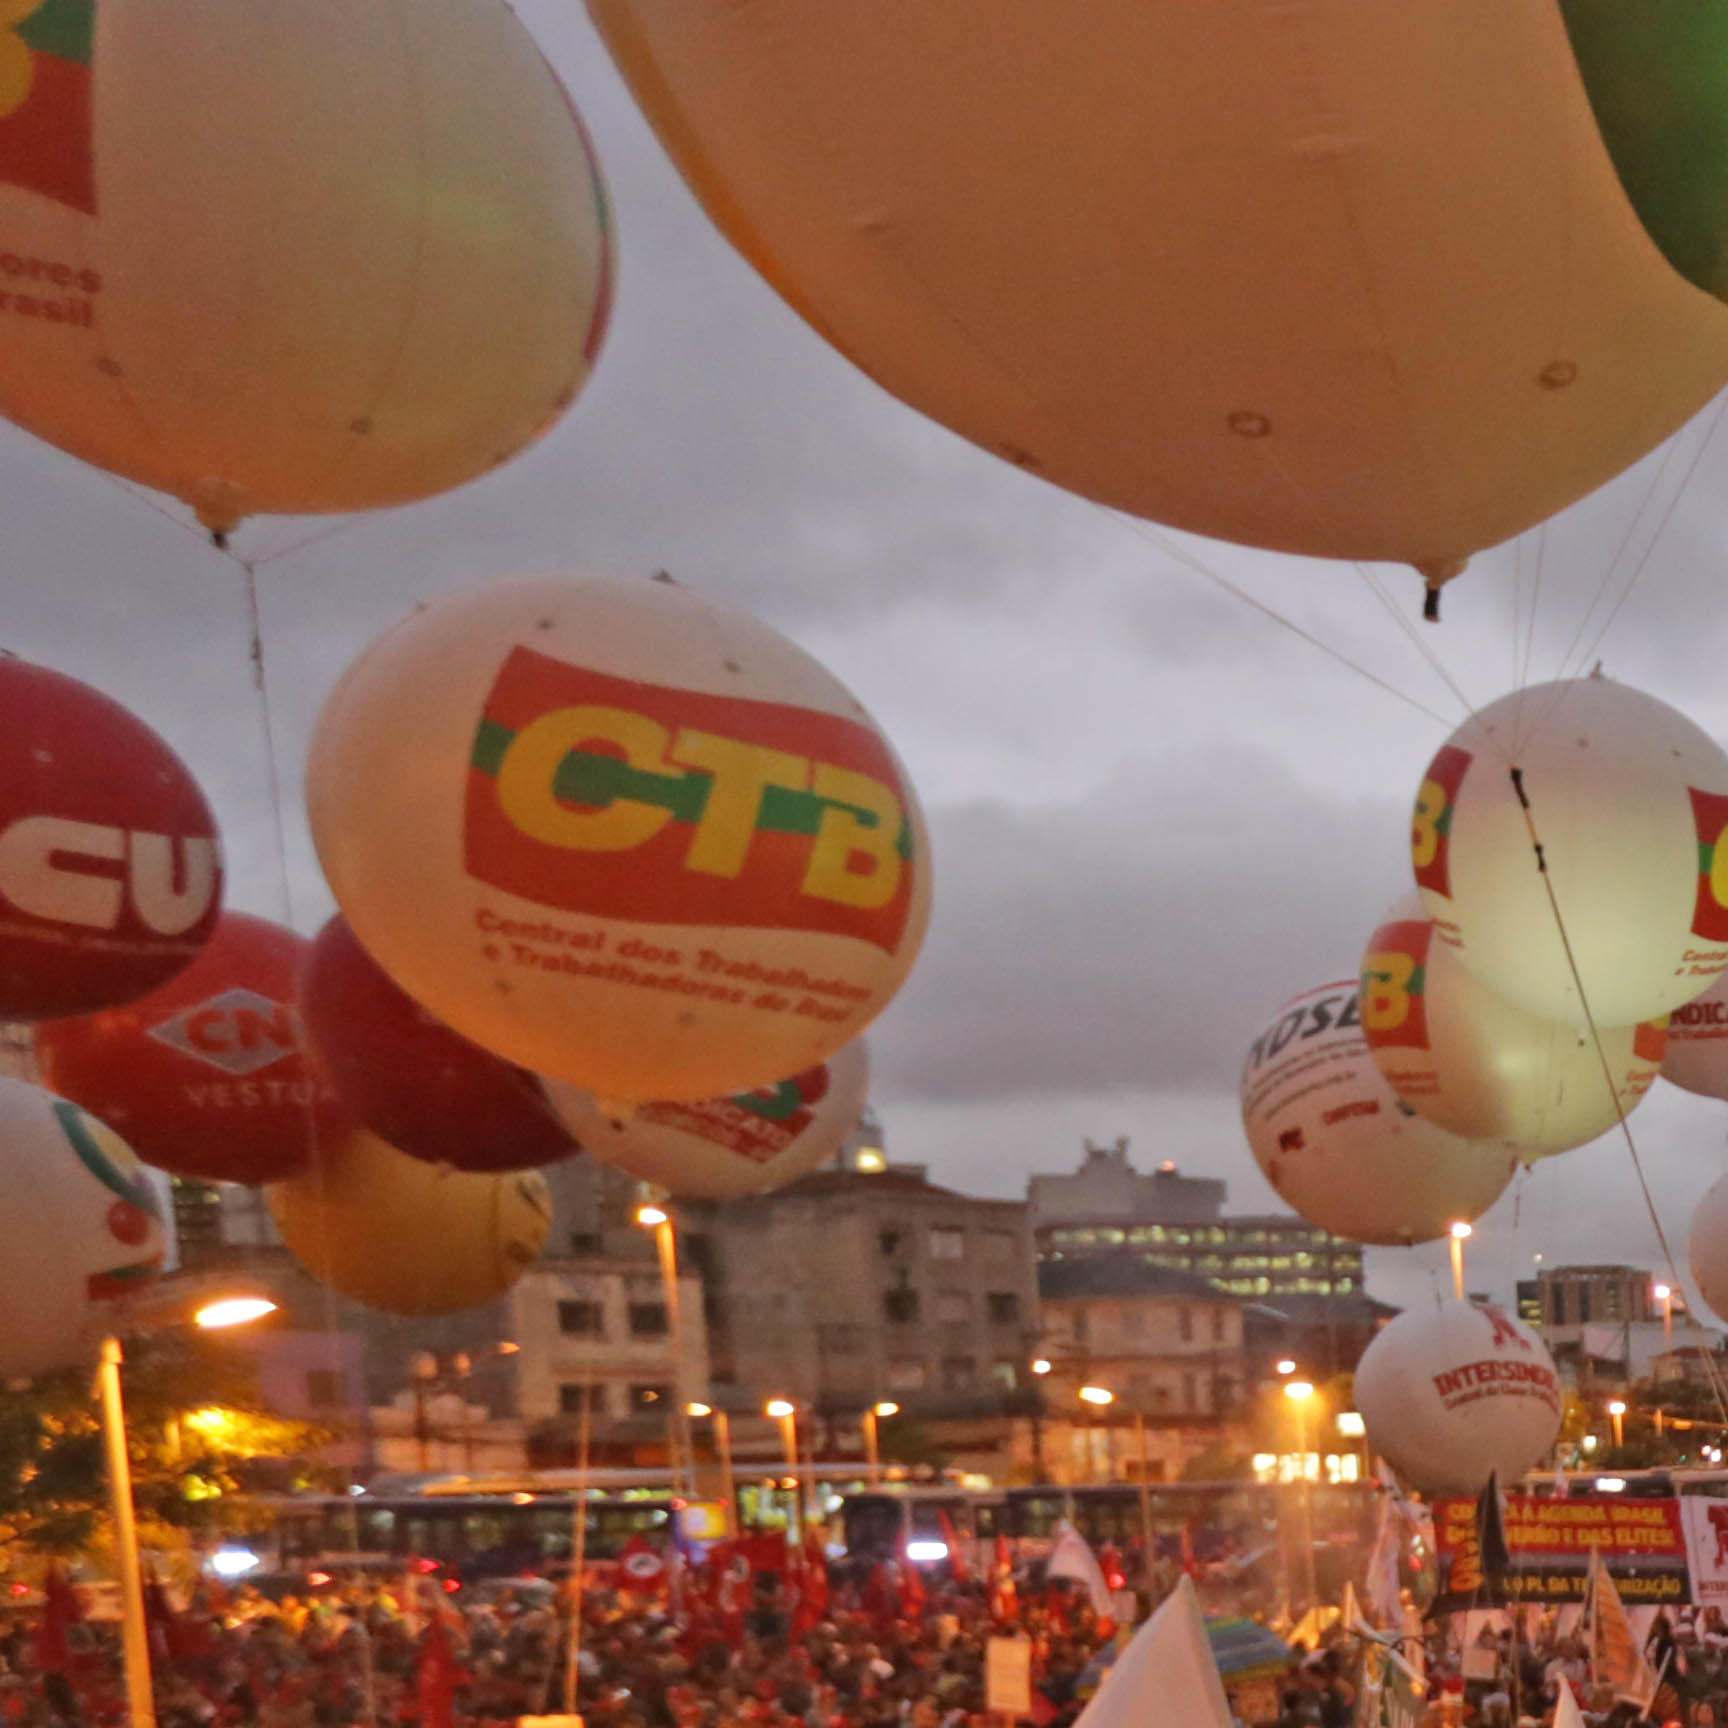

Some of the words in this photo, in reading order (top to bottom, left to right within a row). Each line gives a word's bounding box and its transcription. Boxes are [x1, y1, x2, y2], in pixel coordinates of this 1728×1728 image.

[498, 704, 903, 910] CTB
[475, 907, 606, 951] Central
[615, 937, 681, 967] dos
